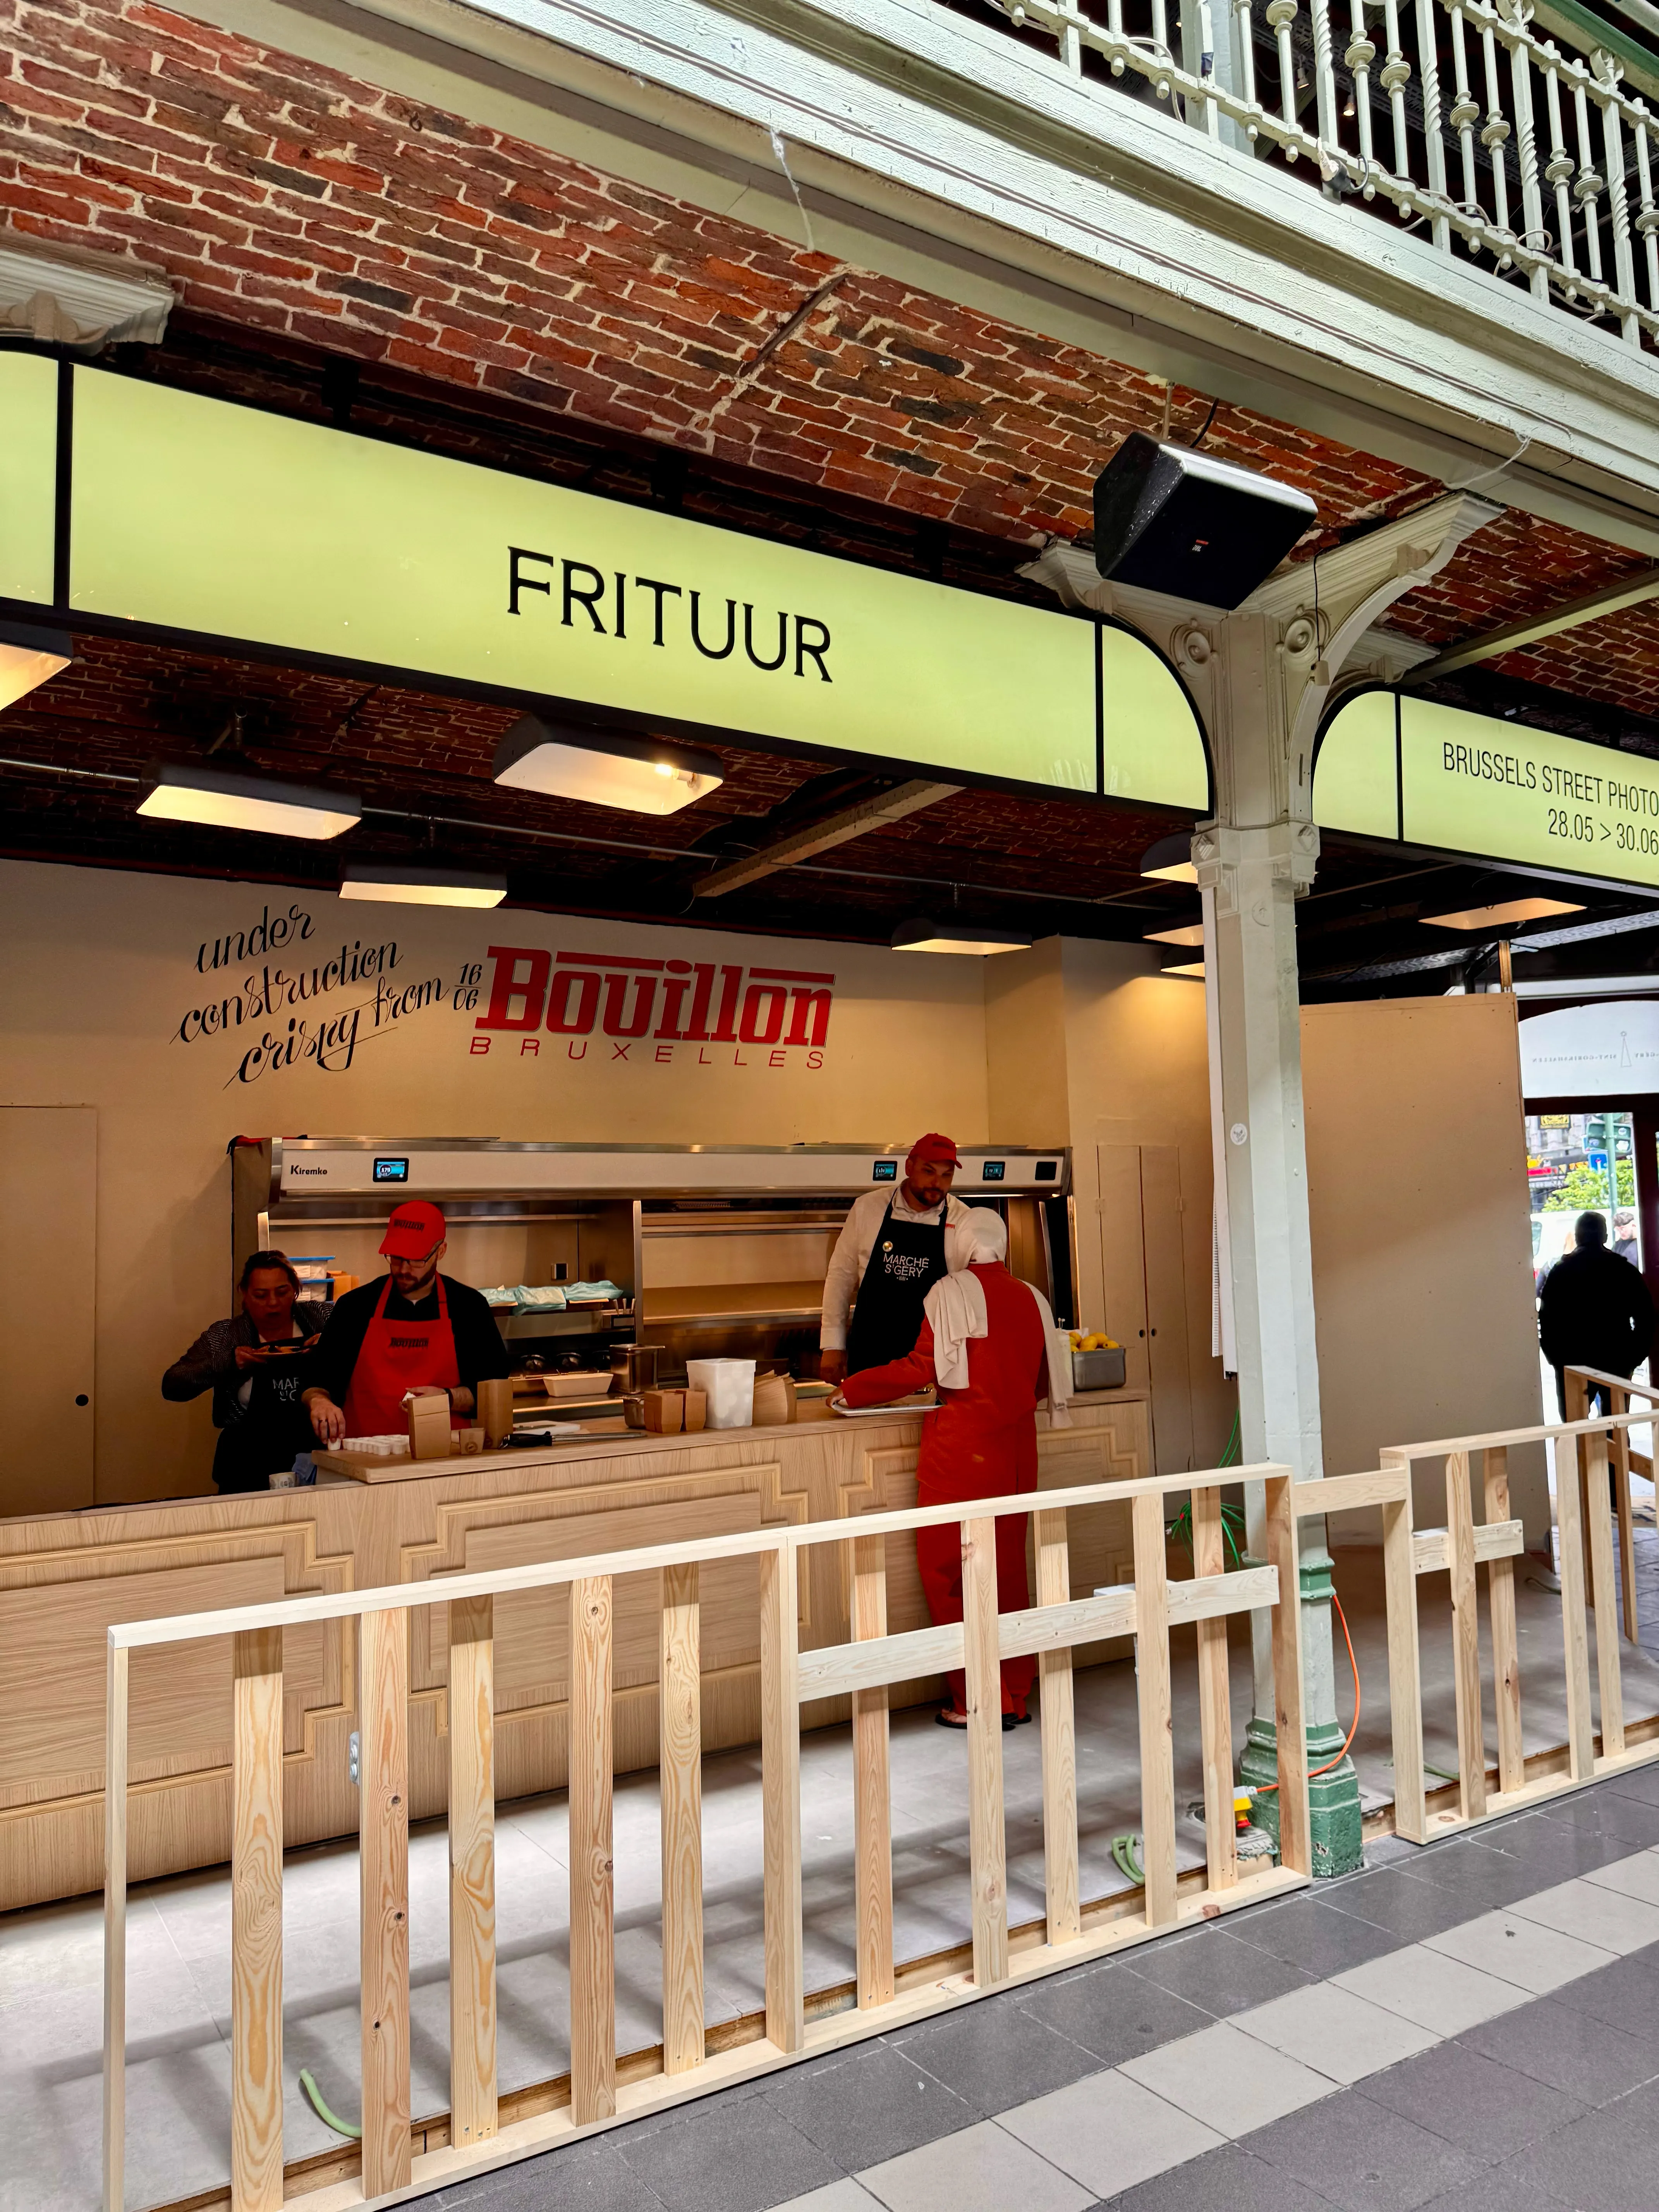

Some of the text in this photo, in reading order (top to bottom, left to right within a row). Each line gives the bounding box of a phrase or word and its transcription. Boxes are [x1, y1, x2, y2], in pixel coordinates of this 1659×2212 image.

[508, 546, 833, 683] FRITUUR
[1443, 742, 1659, 816] BRUSSELS STREET PHOTO
[1548, 808, 1594, 842] 28.05
[1617, 823, 1659, 855] 30.06
[194, 904, 315, 973] under
[169, 940, 403, 1044] construction
[453, 988, 479, 1010] 06
[459, 963, 482, 985] 16
[475, 945, 836, 1047] Bouillon
[223, 975, 449, 1090] crispy from
[469, 1036, 824, 1069] BRUXELLES
[290, 1165, 328, 1175] Kiremko
[883, 1253, 929, 1268] MARCHÉ
